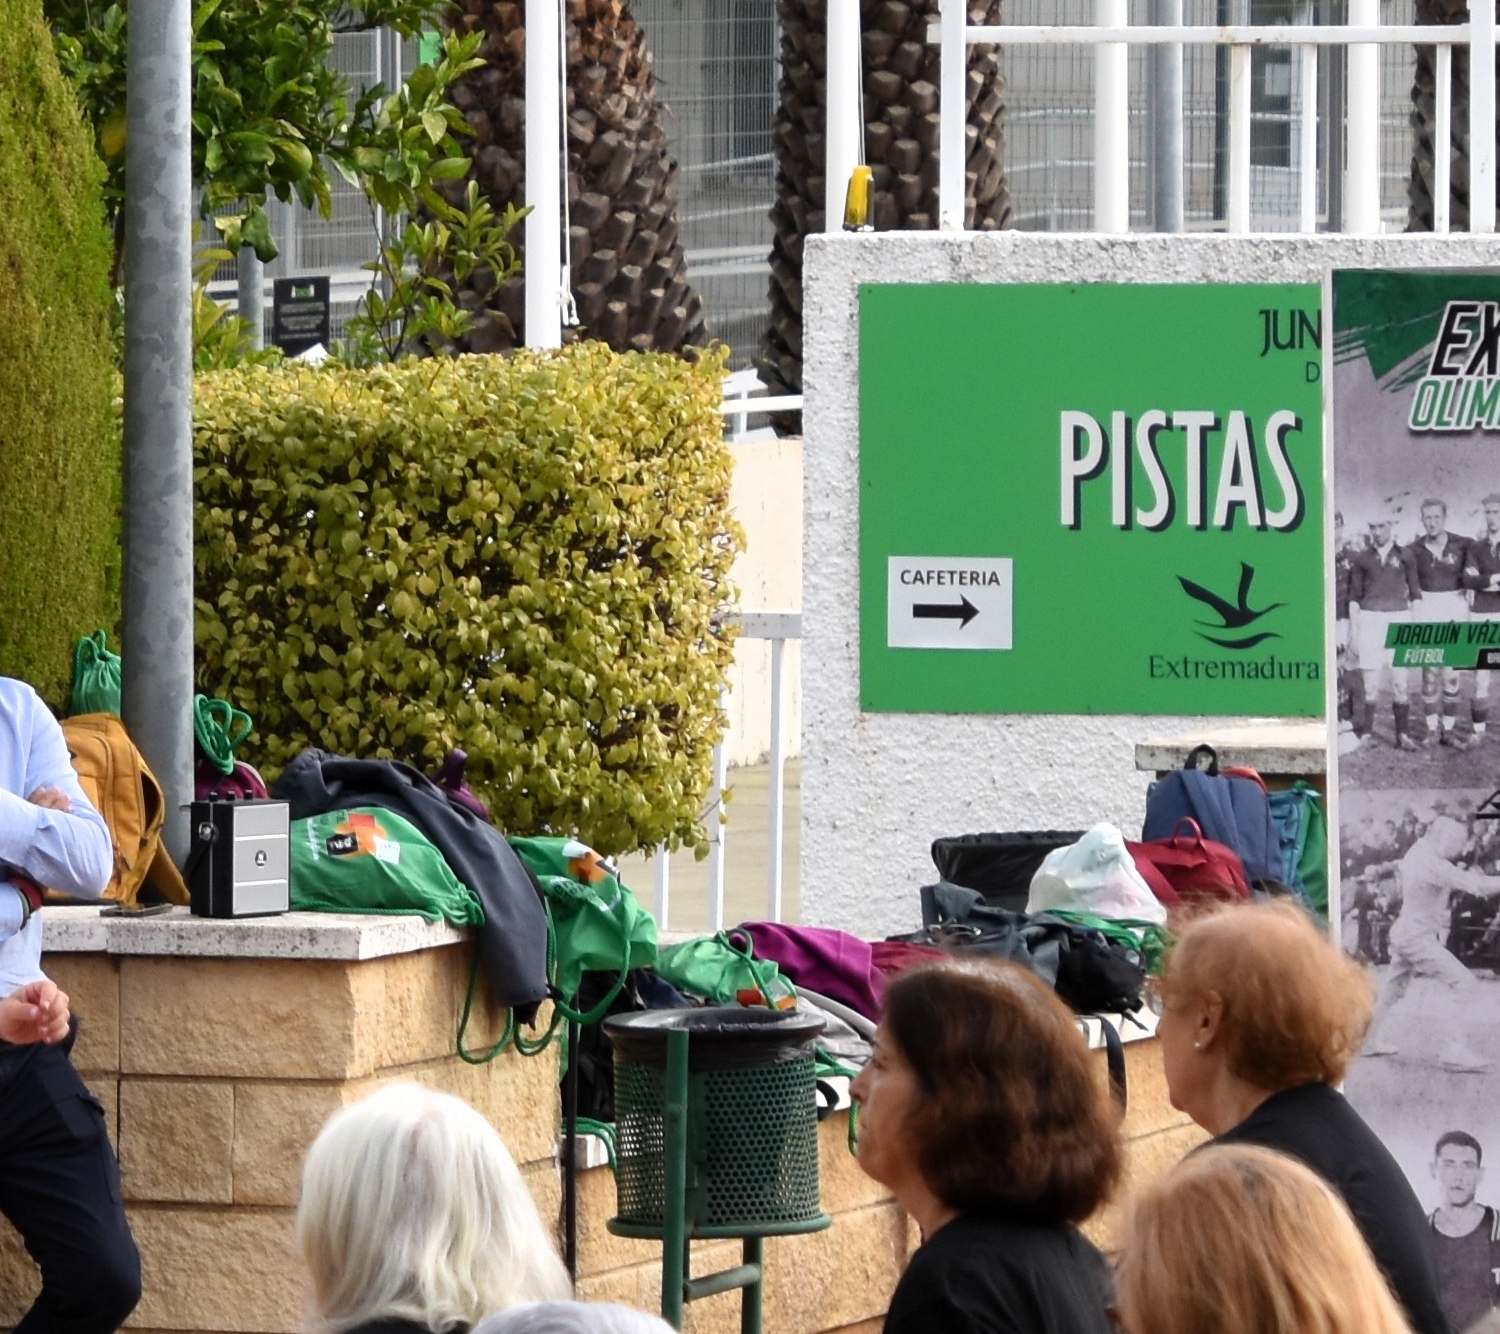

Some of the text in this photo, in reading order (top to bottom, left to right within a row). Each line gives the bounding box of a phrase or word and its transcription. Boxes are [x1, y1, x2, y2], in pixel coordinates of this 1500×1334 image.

[1060, 409, 1306, 532] PISTAS
[900, 569, 1001, 586] CAFETERIA
[1393, 619, 1461, 645] JOAQUÍN
[1404, 646, 1444, 663] FÚTBOL
[1149, 656, 1320, 680] Extremadura
